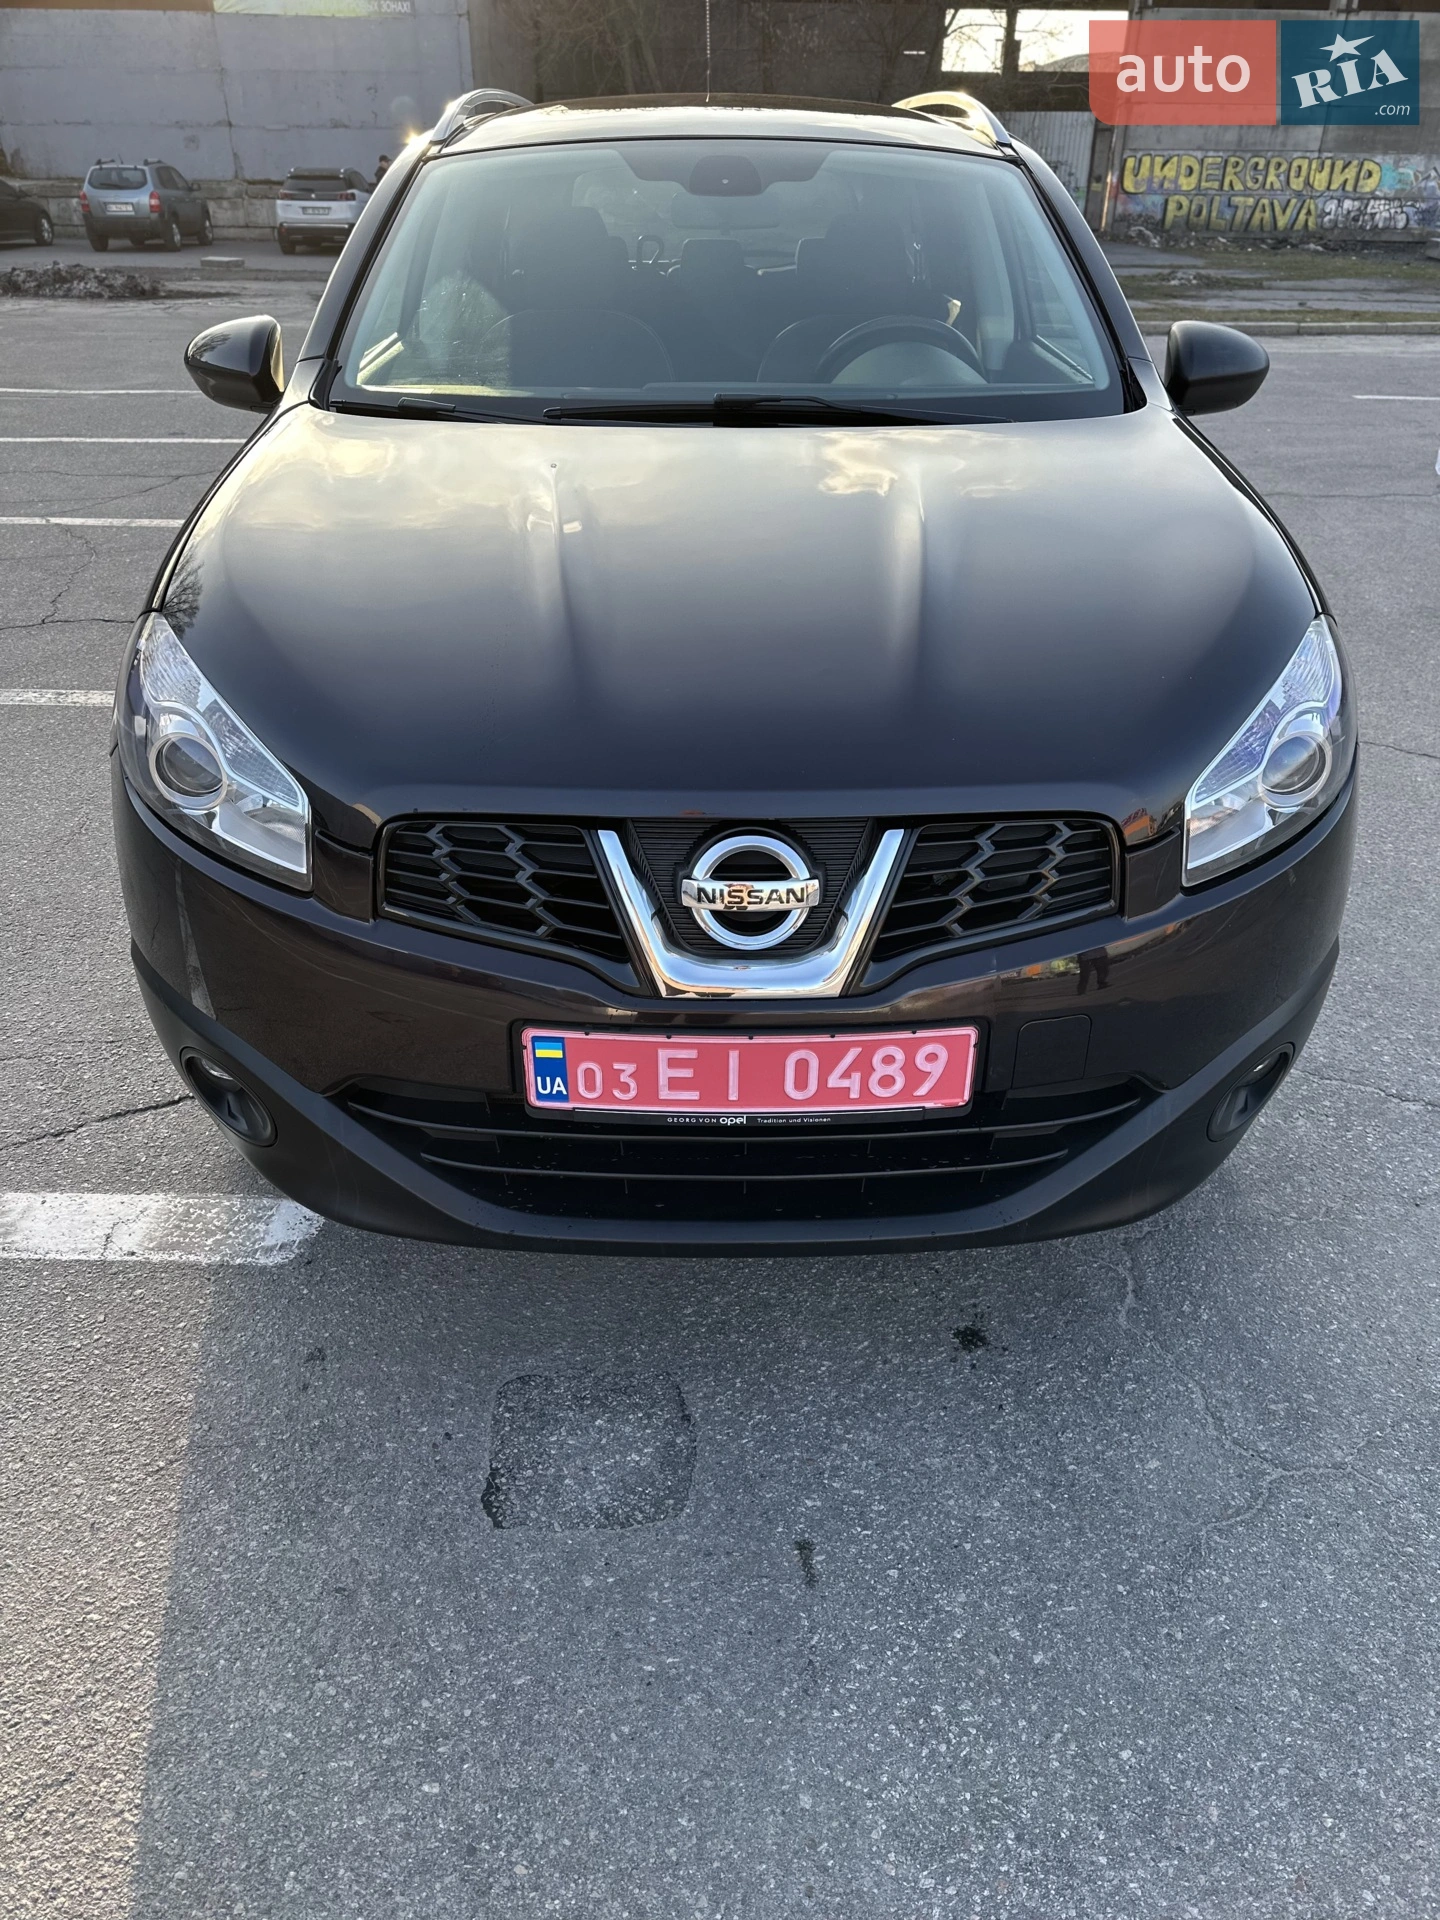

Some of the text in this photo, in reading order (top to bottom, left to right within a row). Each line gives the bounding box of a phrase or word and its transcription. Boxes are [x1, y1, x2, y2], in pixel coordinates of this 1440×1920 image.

[1121, 154, 1382, 194] UNDERGROUND
[1162, 194, 1318, 232] POLTAVA
[696, 886, 805, 906] NISSAN
[537, 1076, 568, 1095] UA
[576, 1062, 638, 1101] 03
[783, 1043, 949, 1101] 0489
[719, 1115, 747, 1126] opel
